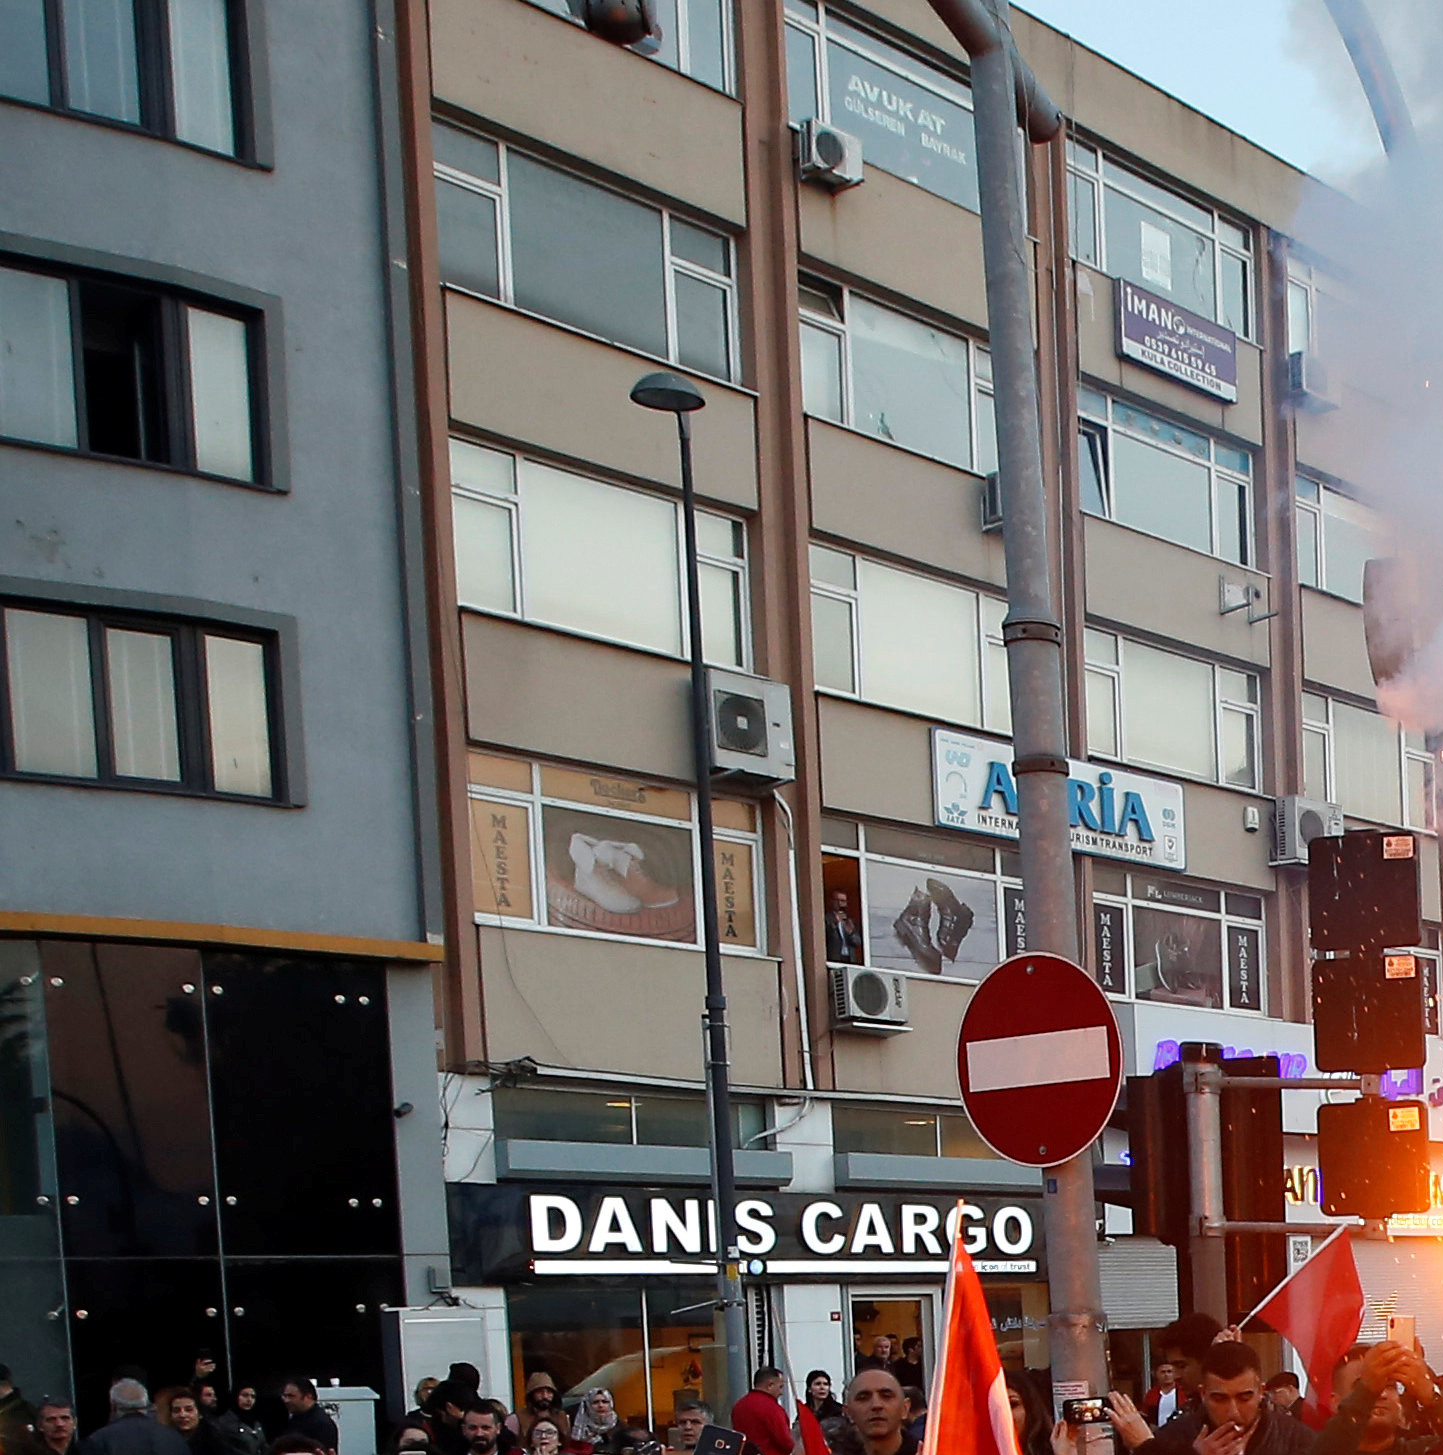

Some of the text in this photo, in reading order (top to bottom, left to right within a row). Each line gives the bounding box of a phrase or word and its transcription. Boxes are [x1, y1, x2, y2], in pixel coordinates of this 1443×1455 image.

[848, 75, 946, 135] AVUKAT
[1168, 361, 1222, 391] COLLECTION
[978, 761, 1155, 843] ARİA
[491, 813, 511, 908] MAESTA
[977, 813, 1019, 831] INTERNA
[1070, 832, 1098, 846] URISM
[1100, 838, 1153, 857] TRANSPORT
[721, 852, 738, 938] MAESTA
[1014, 898, 1026, 953] MAES
[1100, 913, 1113, 986] MAESTA
[1238, 935, 1250, 1004] MAESTA
[801, 1202, 1033, 1255] CARGO
